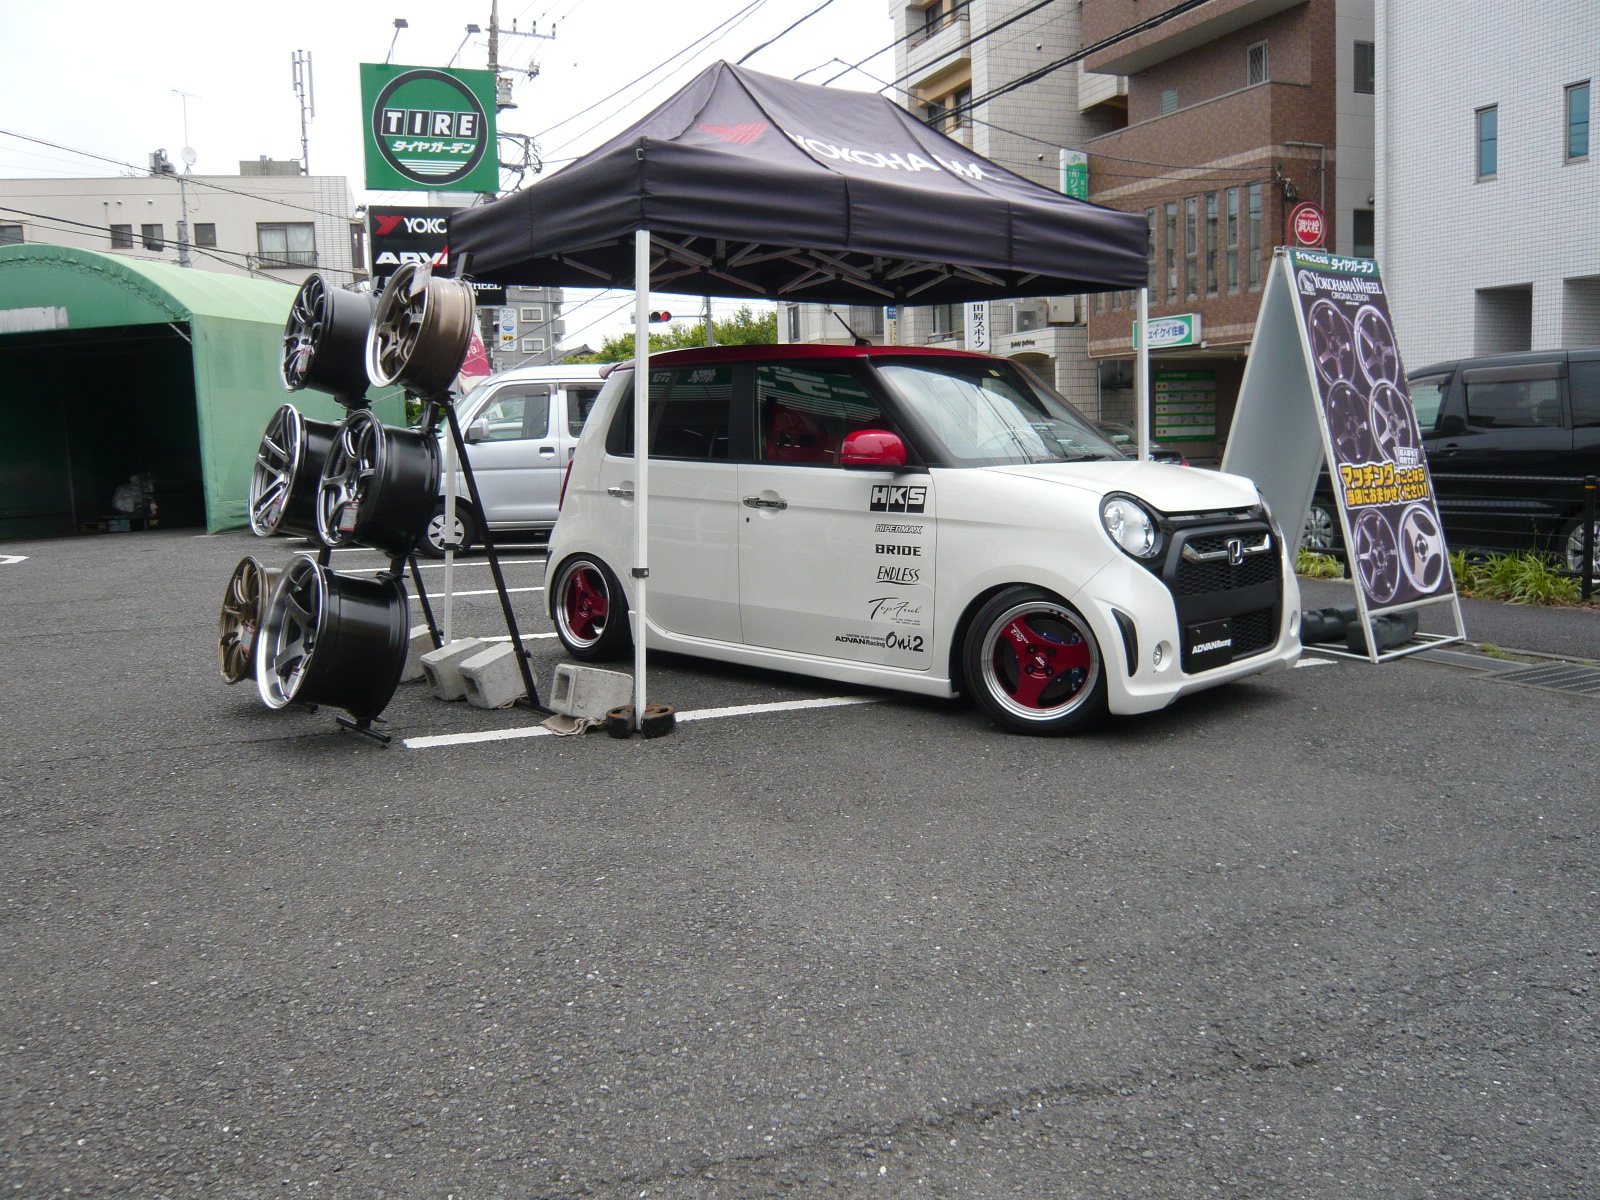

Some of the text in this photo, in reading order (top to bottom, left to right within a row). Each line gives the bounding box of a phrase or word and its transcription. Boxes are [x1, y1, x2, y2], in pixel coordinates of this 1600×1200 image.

[387, 111, 474, 136] TIRE
[391, 141, 476, 154] タイヤガーデン
[403, 217, 447, 234] YOKO
[1298, 219, 1320, 234] 消火栓
[1331, 258, 1374, 273] タイヤガーデン
[1311, 272, 1383, 294] YOKOHAMA WHEEL
[973, 302, 985, 348] 田原スポーツ
[871, 486, 926, 506] HKS
[875, 523, 924, 534] HIPERMAX
[875, 544, 922, 557] BRIDE
[877, 566, 920, 583] ENDLESS
